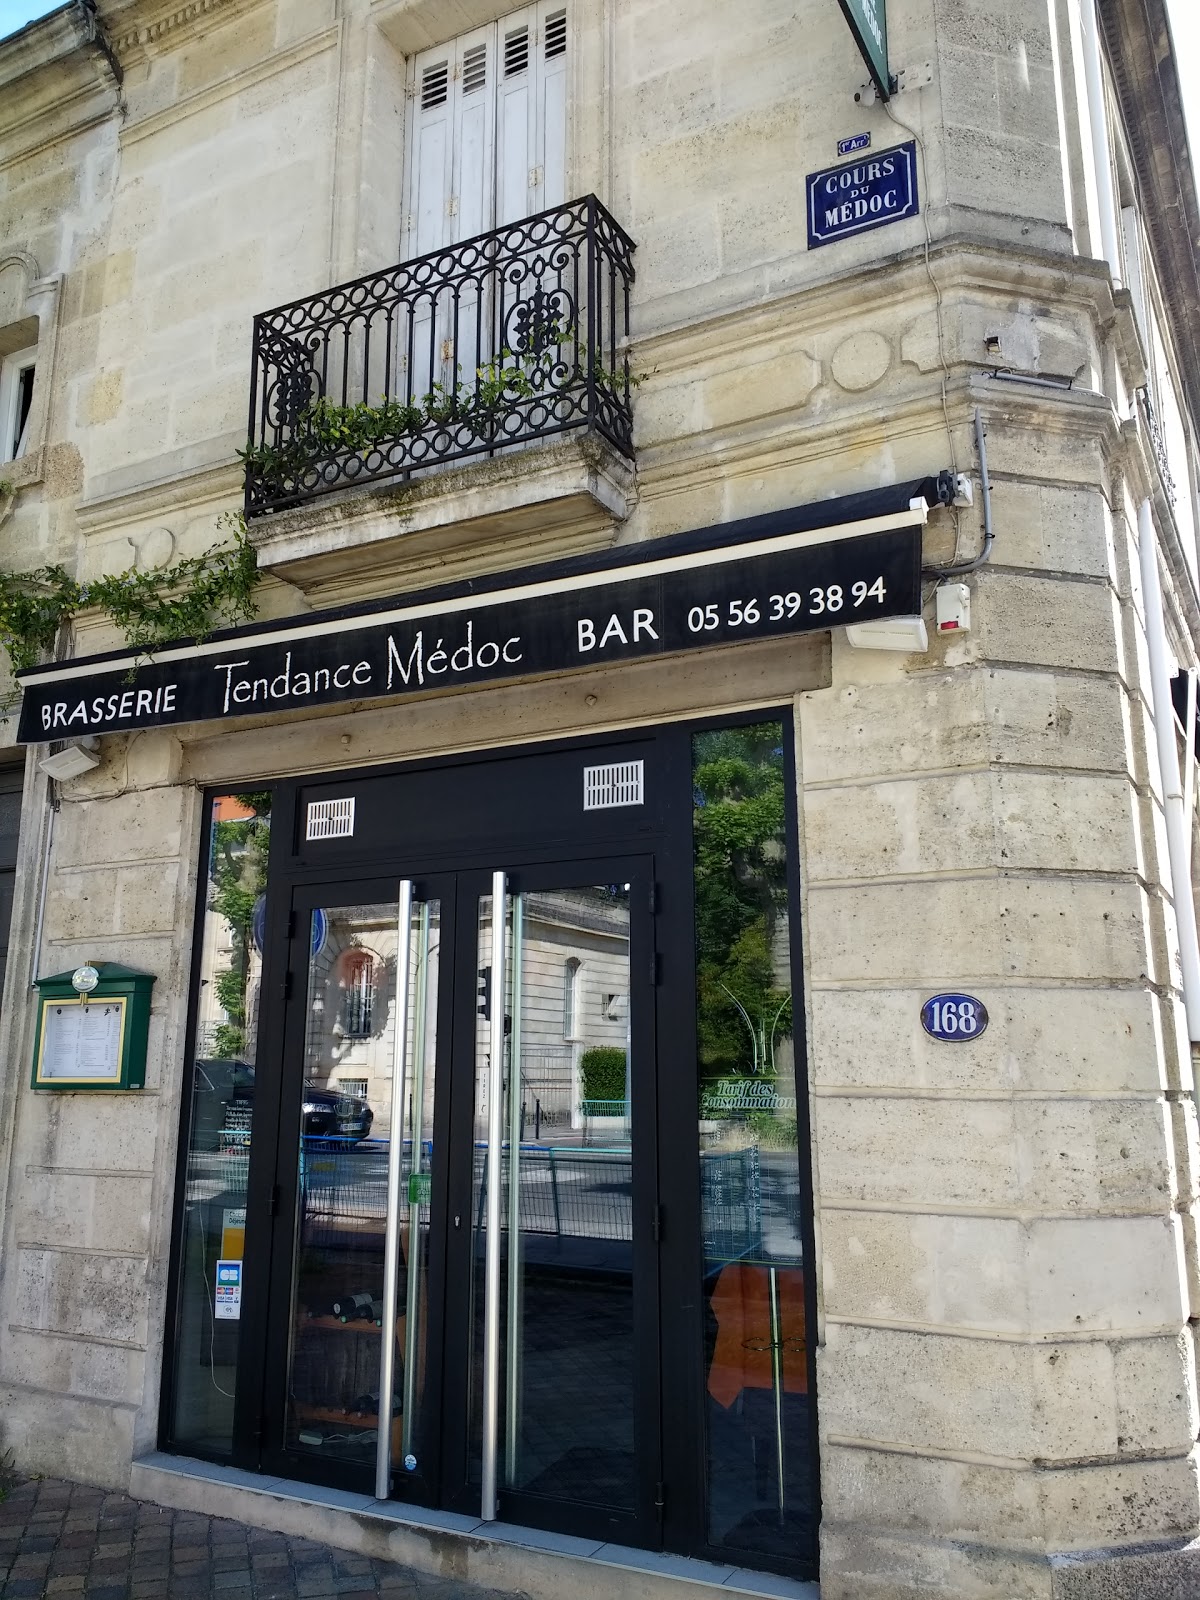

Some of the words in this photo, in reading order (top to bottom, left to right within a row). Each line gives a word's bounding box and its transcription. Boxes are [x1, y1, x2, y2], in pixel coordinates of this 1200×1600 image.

[825, 158, 895, 194] COURS
[850, 185, 870, 198] DU
[825, 189, 897, 228] MÉDOC
[41, 684, 177, 731] BRASSERIE
[214, 651, 372, 714] Tendance
[387, 620, 523, 690] Médoc
[577, 608, 660, 653] BAR
[687, 604, 720, 633] 05
[727, 598, 761, 627] 56
[769, 592, 801, 621] 39
[809, 584, 844, 615] 38
[851, 575, 887, 608] 94
[931, 1002, 977, 1033] 168
[717, 1080, 751, 1097] Tarif
[750, 1080, 774, 1096] des
[220, 1269, 238, 1281] CB
